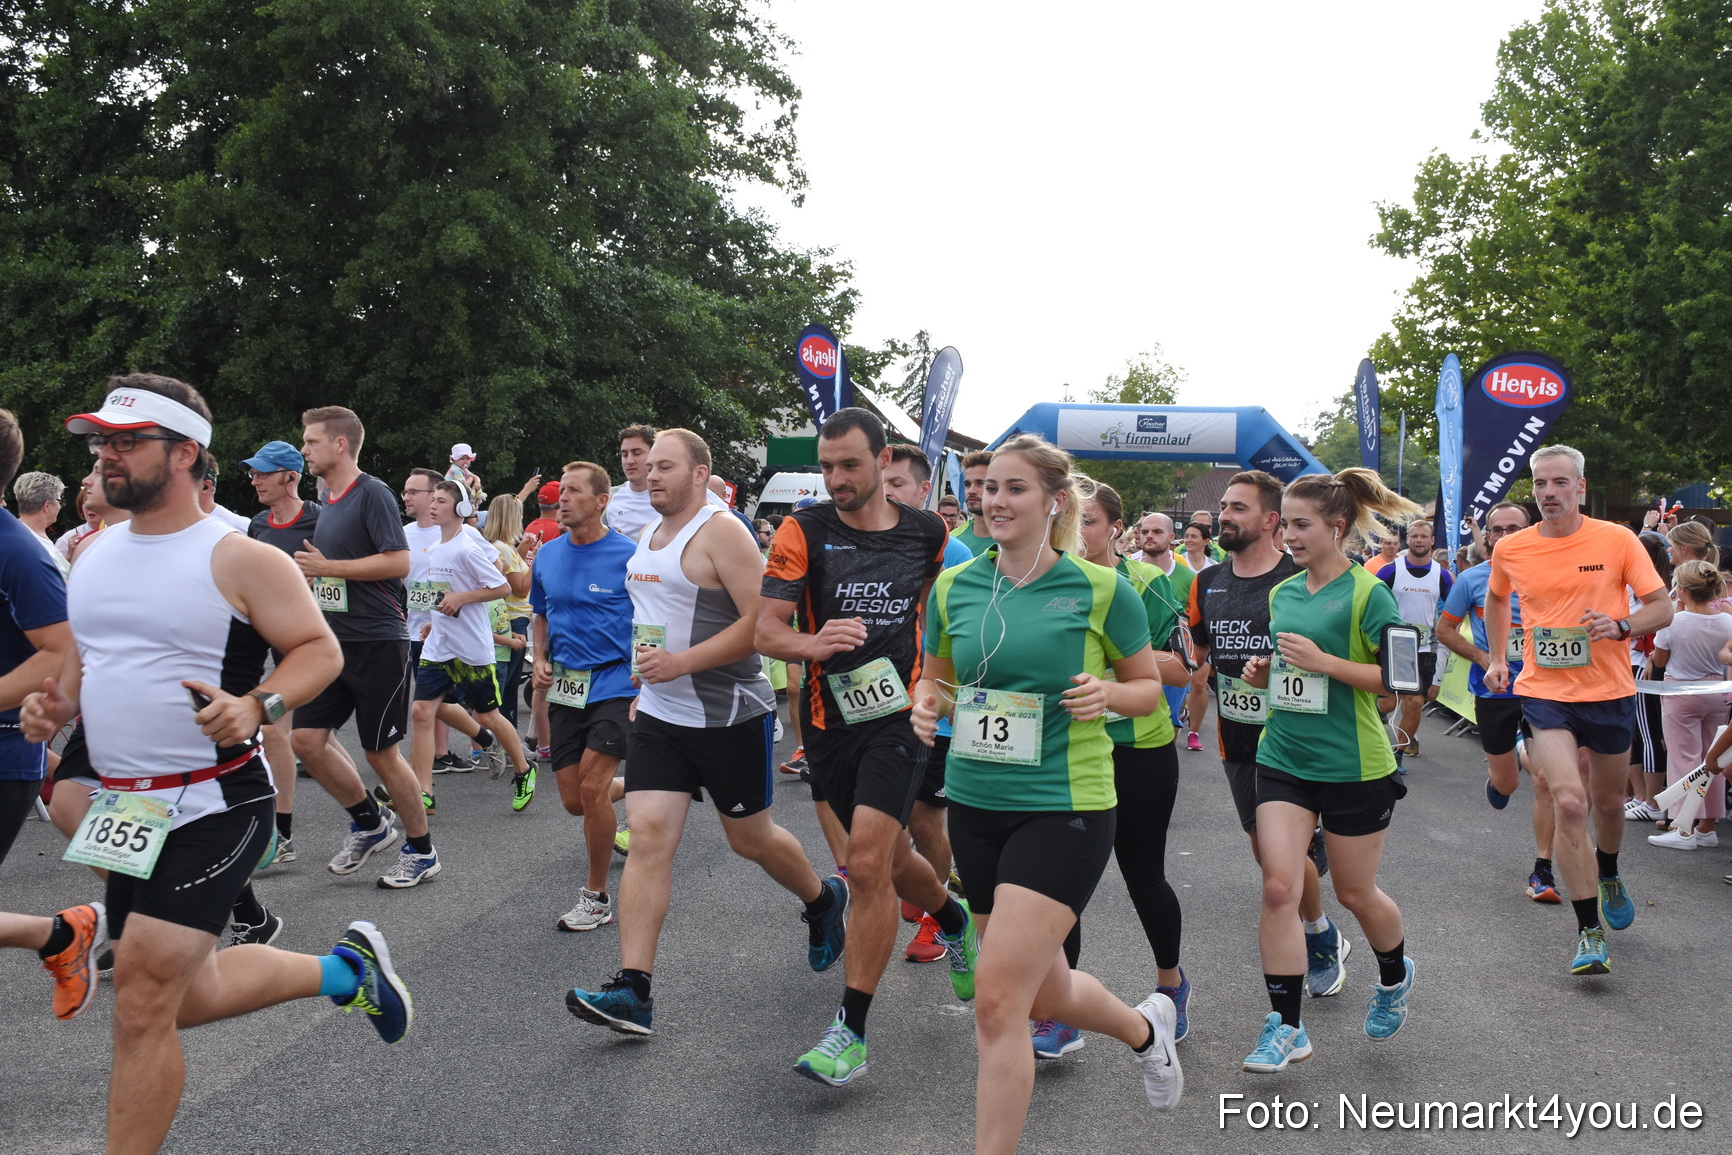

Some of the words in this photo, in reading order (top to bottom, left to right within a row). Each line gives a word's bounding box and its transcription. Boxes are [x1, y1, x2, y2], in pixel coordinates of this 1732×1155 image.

[1491, 372, 1558, 398] Hervis
[1126, 432, 1192, 446] firmenlauf
[634, 574, 662, 582] KLEBL
[316, 586, 341, 601] 1490
[410, 591, 428, 603] 236
[835, 582, 893, 598] HECK
[841, 597, 913, 614] DESIGN
[1210, 620, 1252, 634] HECK
[1216, 636, 1274, 649] DESIGN
[1539, 642, 1581, 656] 2310
[557, 678, 584, 696] 1064
[843, 678, 894, 708] 1016
[1283, 676, 1303, 696] 10
[1223, 691, 1260, 711] 2439
[978, 715, 1009, 742] 13
[971, 740, 992, 749] Schön
[86, 816, 153, 852] 1855
